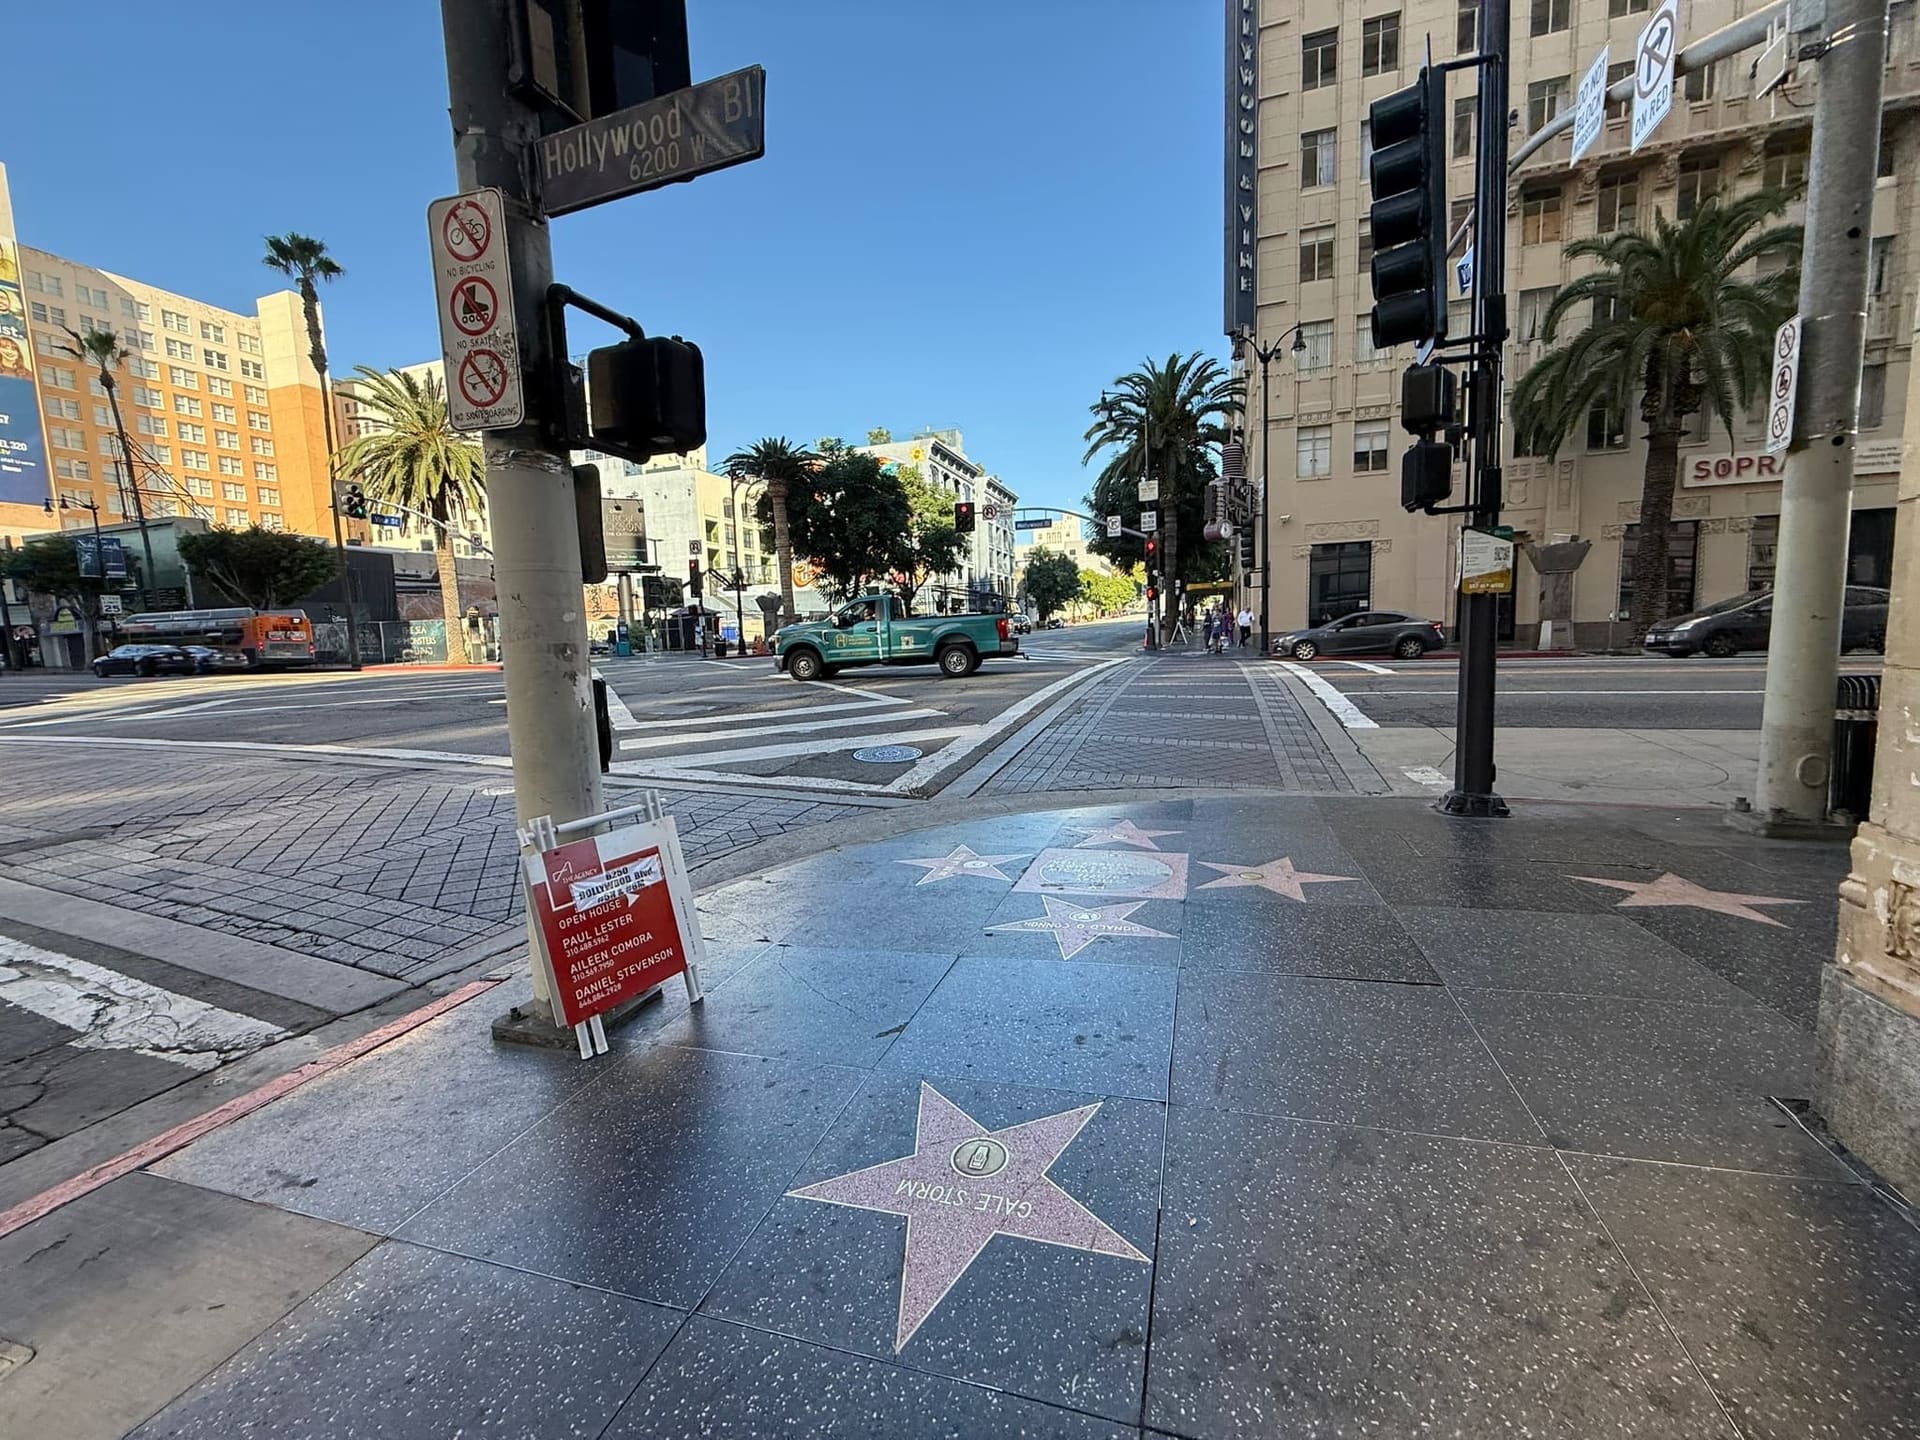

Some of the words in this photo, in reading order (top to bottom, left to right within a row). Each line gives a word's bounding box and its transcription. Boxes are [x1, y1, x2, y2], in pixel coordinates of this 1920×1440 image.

[1577, 82, 1590, 110] DO
[1590, 57, 1607, 92] NOT
[1576, 88, 1604, 136] BLOCK
[1635, 109, 1648, 137] ON
[1649, 84, 1669, 118] RED
[544, 97, 682, 179] Hollywood
[724, 75, 753, 123] Bl
[629, 141, 680, 181] 6200
[690, 133, 706, 163] W
[1239, 173, 1253, 191] &
[1239, 204, 1253, 292] VINE
[446, 267, 458, 278] NO
[459, 260, 496, 277] BICYCLING
[456, 339, 468, 350] NO
[1693, 455, 1785, 480] SOPR
[562, 874, 574, 884] THE
[574, 867, 598, 881] AGENCY
[579, 875, 632, 900] HOLLYWOOD
[605, 866, 629, 881] 6250
[559, 913, 587, 930] OPEN
[589, 899, 622, 919] HOUSE
[1090, 923, 1140, 932] DONALD
[562, 930, 593, 949] PAUL
[594, 913, 634, 936] LESTER
[570, 950, 609, 975] AILEEN
[611, 931, 654, 956] COMORA
[575, 975, 615, 1000] DANIEL
[616, 947, 674, 981] STEVENSON
[894, 1178, 969, 1207] STORM
[974, 1192, 1032, 1218] GALE
